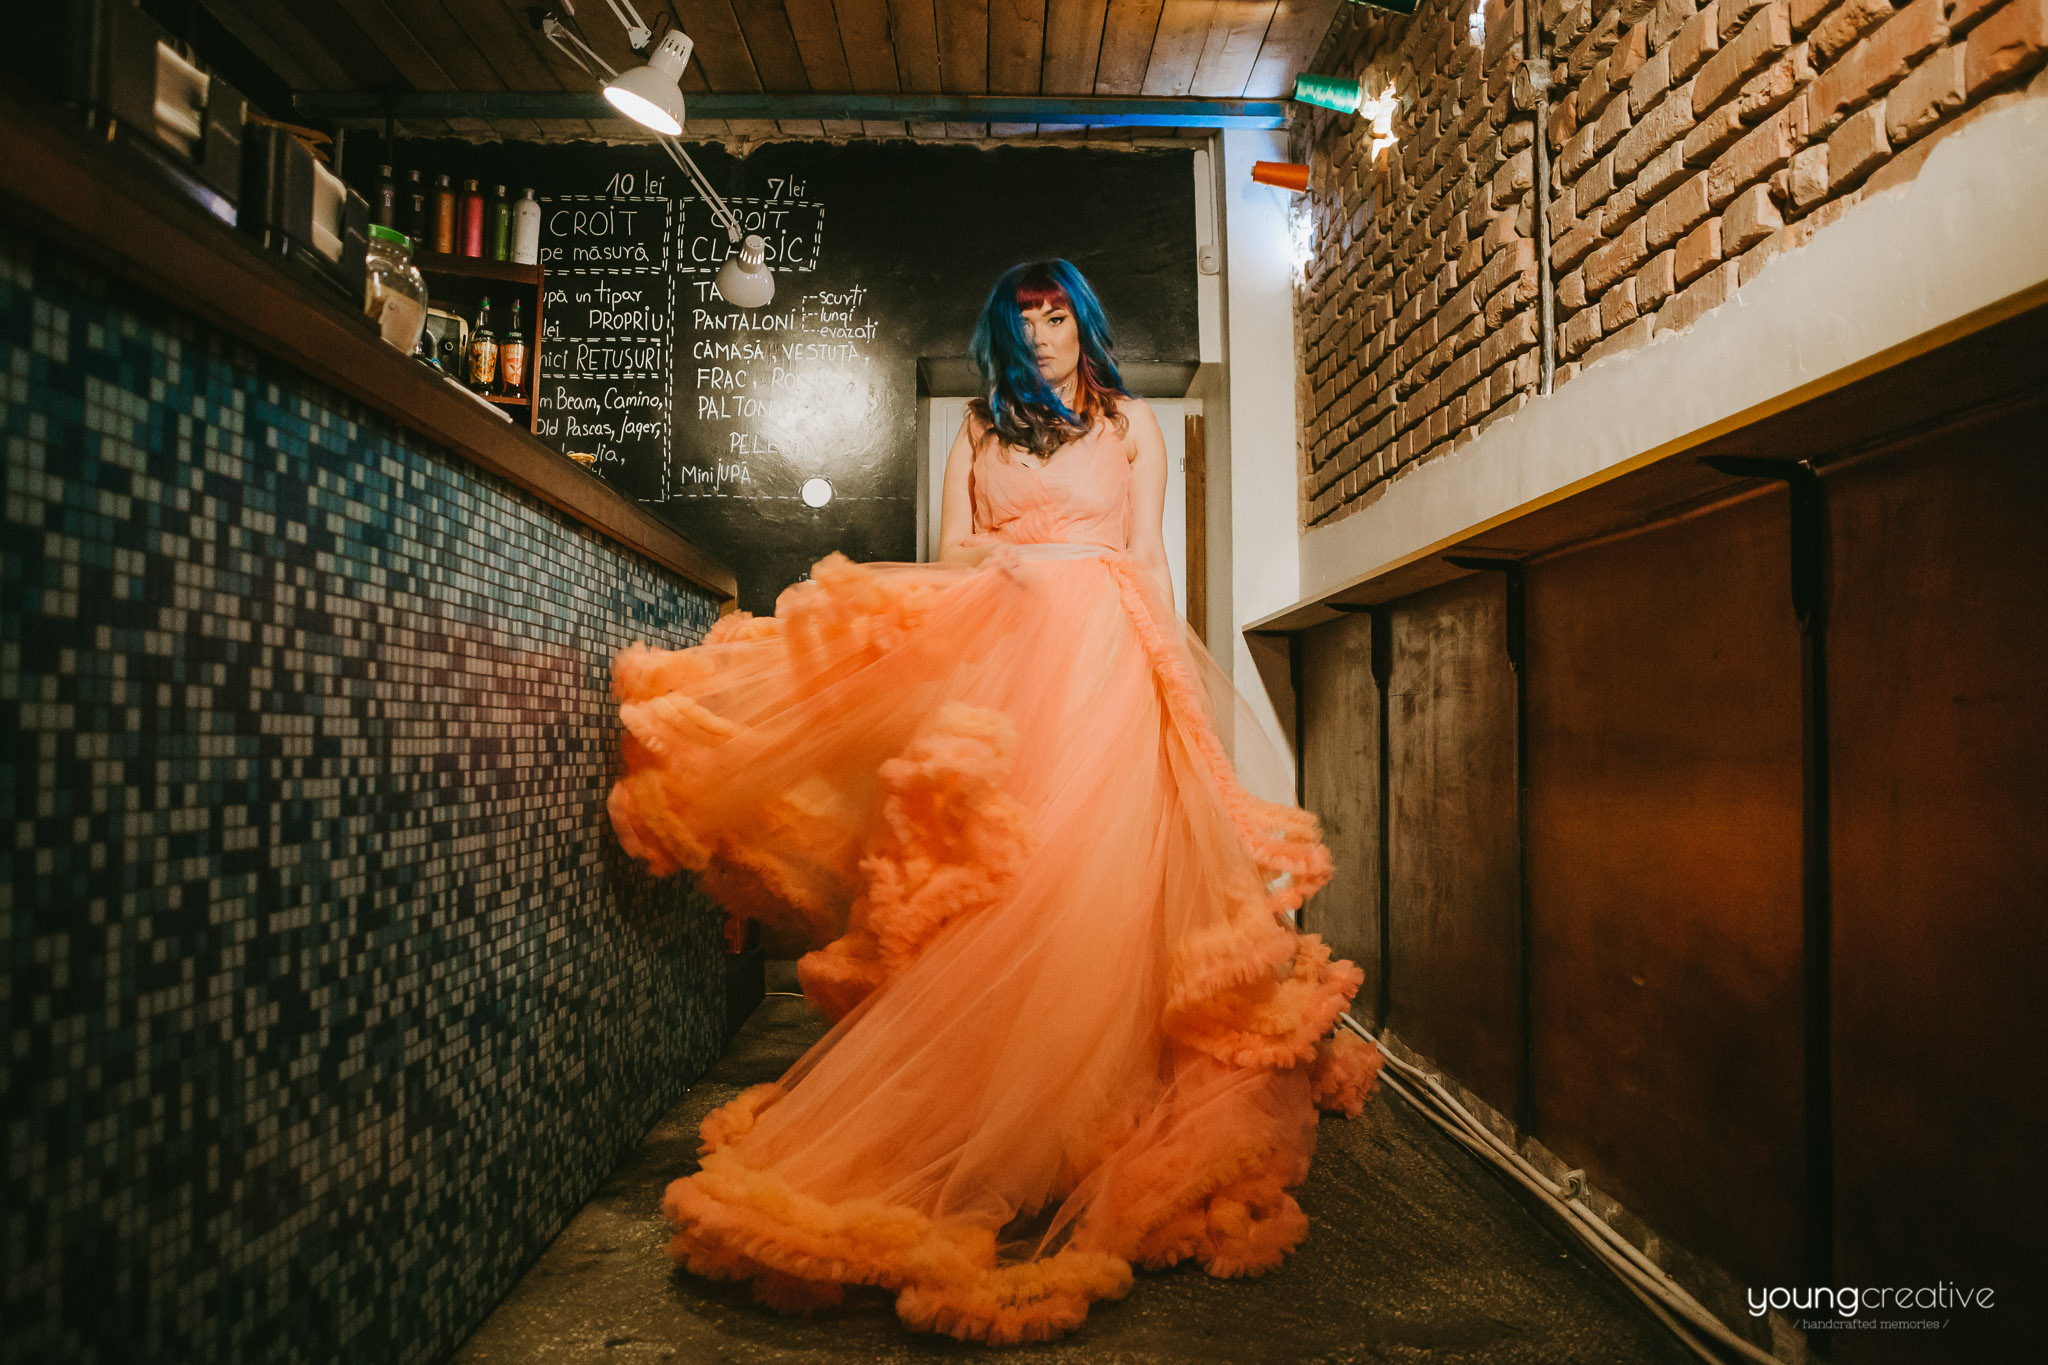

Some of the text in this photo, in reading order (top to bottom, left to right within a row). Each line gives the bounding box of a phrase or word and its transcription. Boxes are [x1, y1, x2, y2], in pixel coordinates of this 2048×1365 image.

[605, 169, 666, 196] 10 lei
[768, 174, 807, 200] 7 lei
[540, 247, 563, 264] pe
[691, 228, 803, 263] CLSIC
[575, 292, 592, 303] un
[593, 279, 643, 312] tipar
[556, 385, 601, 416] Beam,
[604, 387, 663, 411] Camino,
